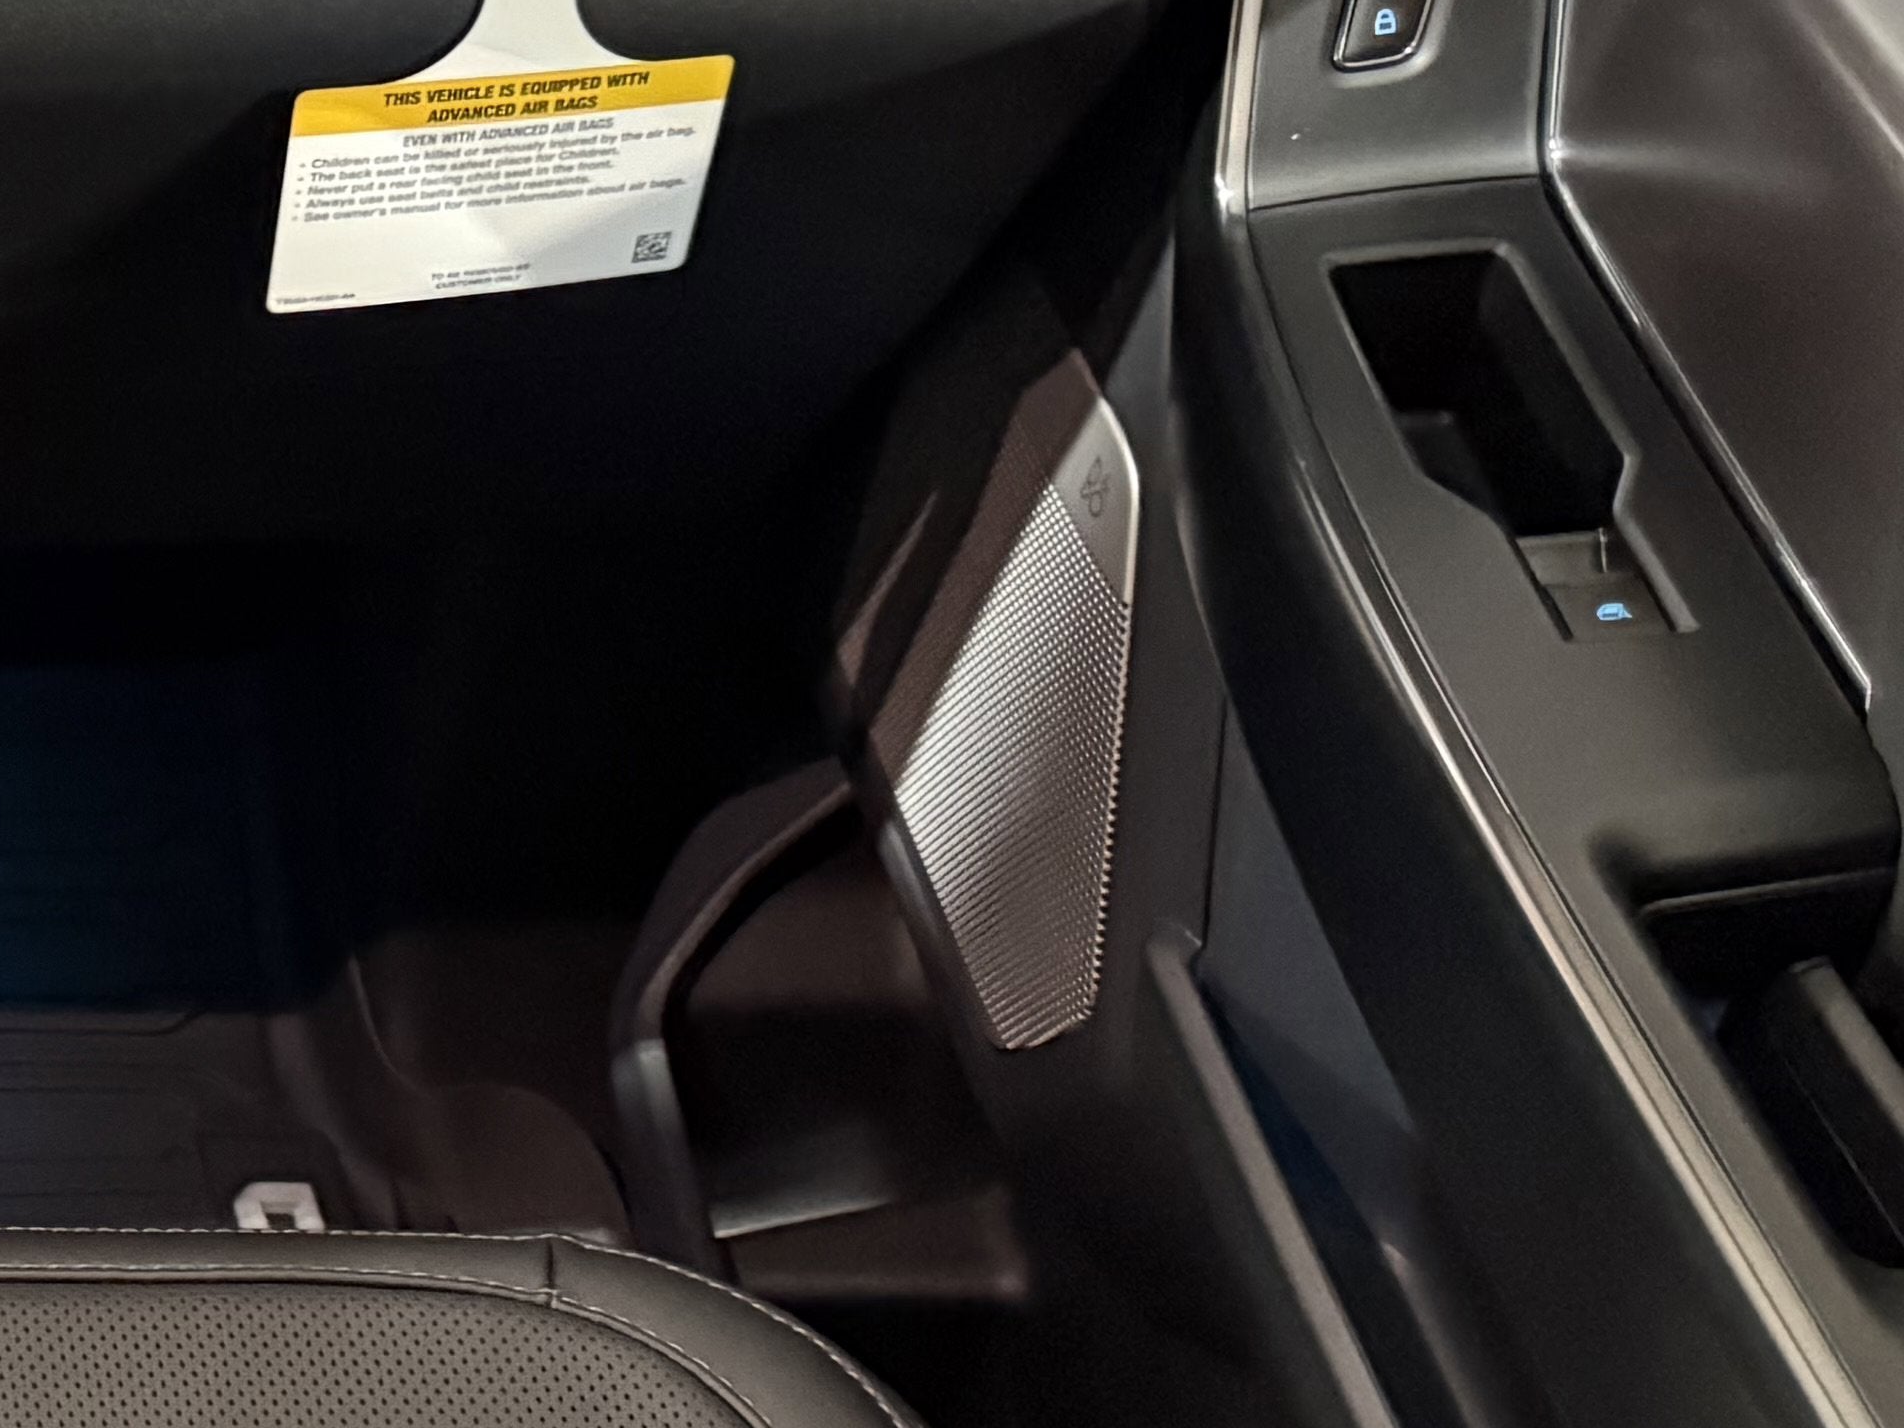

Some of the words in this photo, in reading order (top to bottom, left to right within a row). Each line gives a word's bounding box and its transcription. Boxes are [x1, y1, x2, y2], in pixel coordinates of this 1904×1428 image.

[384, 90, 421, 108] THIS
[427, 84, 494, 104] VEHICLE
[499, 83, 515, 98] IS
[521, 75, 602, 97] EQUIPPED
[607, 71, 651, 89] WITH
[427, 103, 517, 123] ADVANCED
[520, 100, 549, 115] AIR
[554, 96, 599, 112] BAGS
[403, 132, 438, 148] EVEN
[441, 129, 477, 145] WITH
[479, 123, 549, 141] ADVANCED
[551, 121, 577, 135] AIR
[578, 117, 615, 132] BAGS
